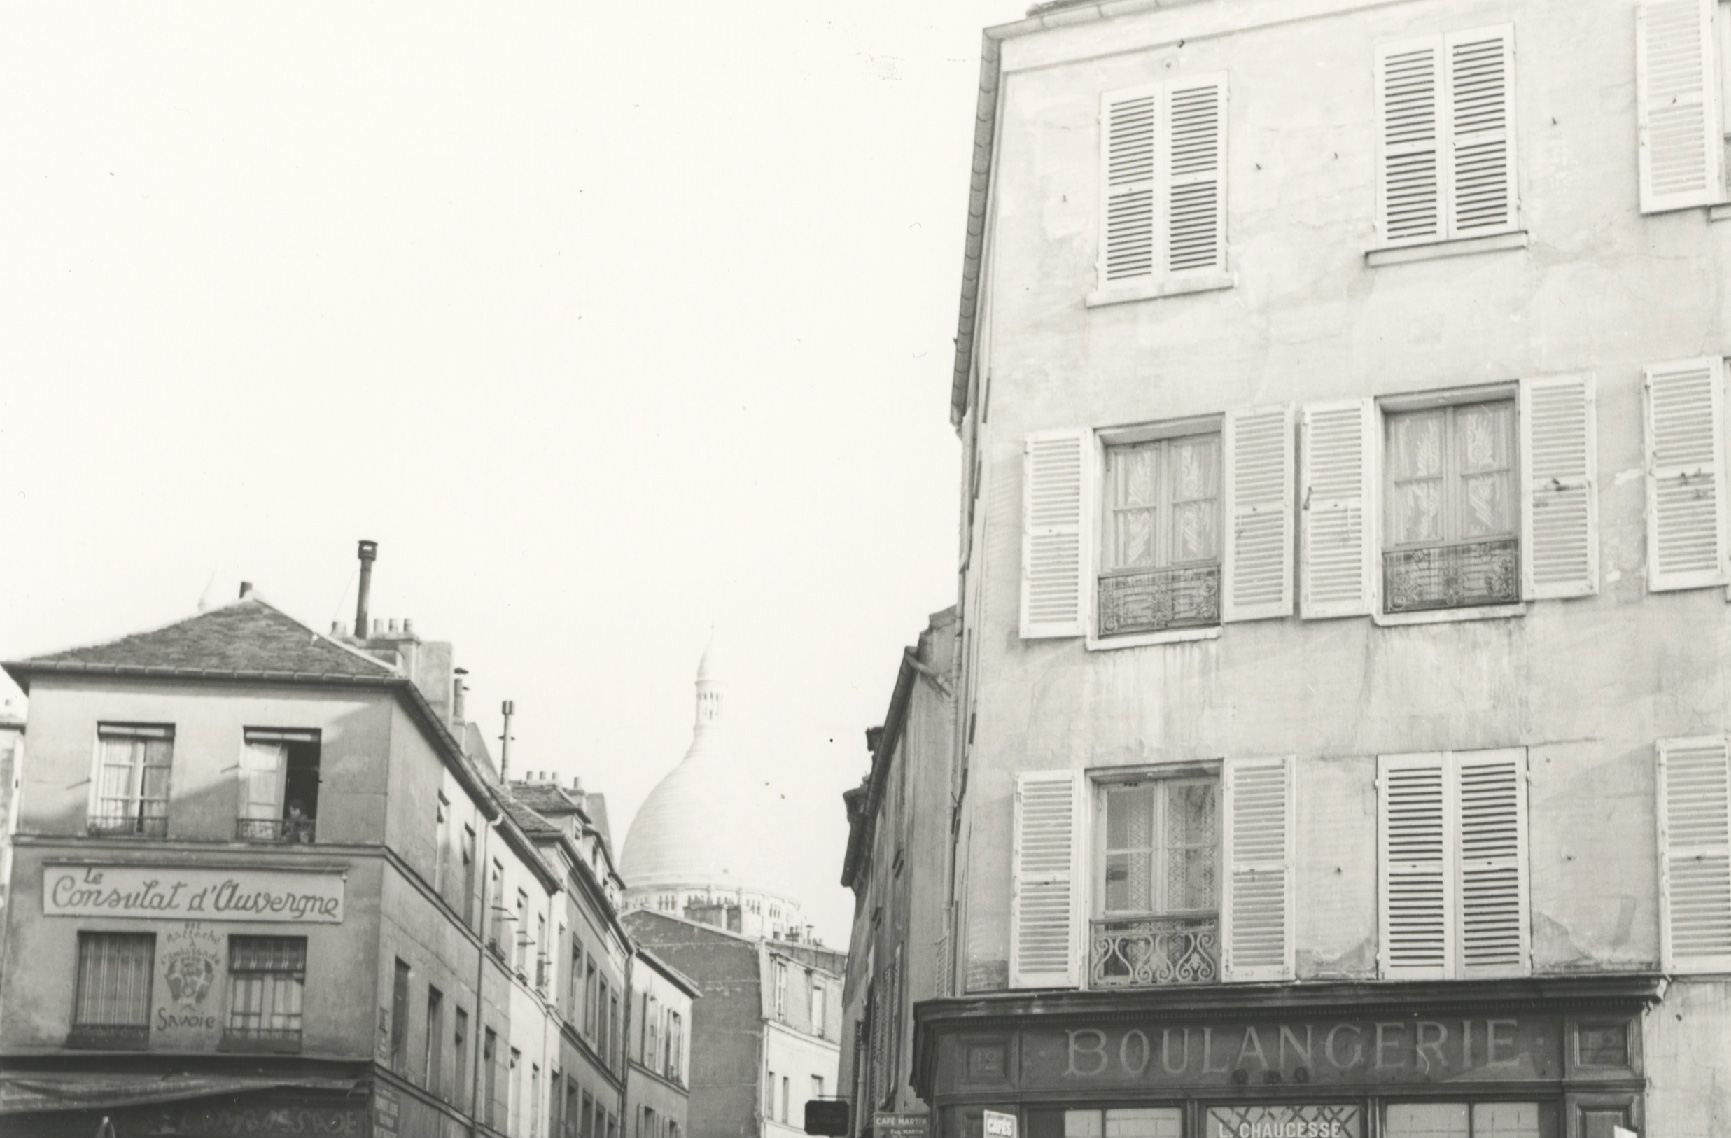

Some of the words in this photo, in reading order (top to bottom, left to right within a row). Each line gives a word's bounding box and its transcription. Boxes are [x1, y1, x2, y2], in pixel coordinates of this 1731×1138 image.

[83, 867, 104, 885] Le
[52, 875, 188, 911] Consulat
[187, 879, 339, 919] d'Auvergne
[1064, 1019, 1521, 1076] BOULANGERIE
[1219, 1122, 1234, 1138] L.
[1239, 1122, 1341, 1138] CHAUCESSE
